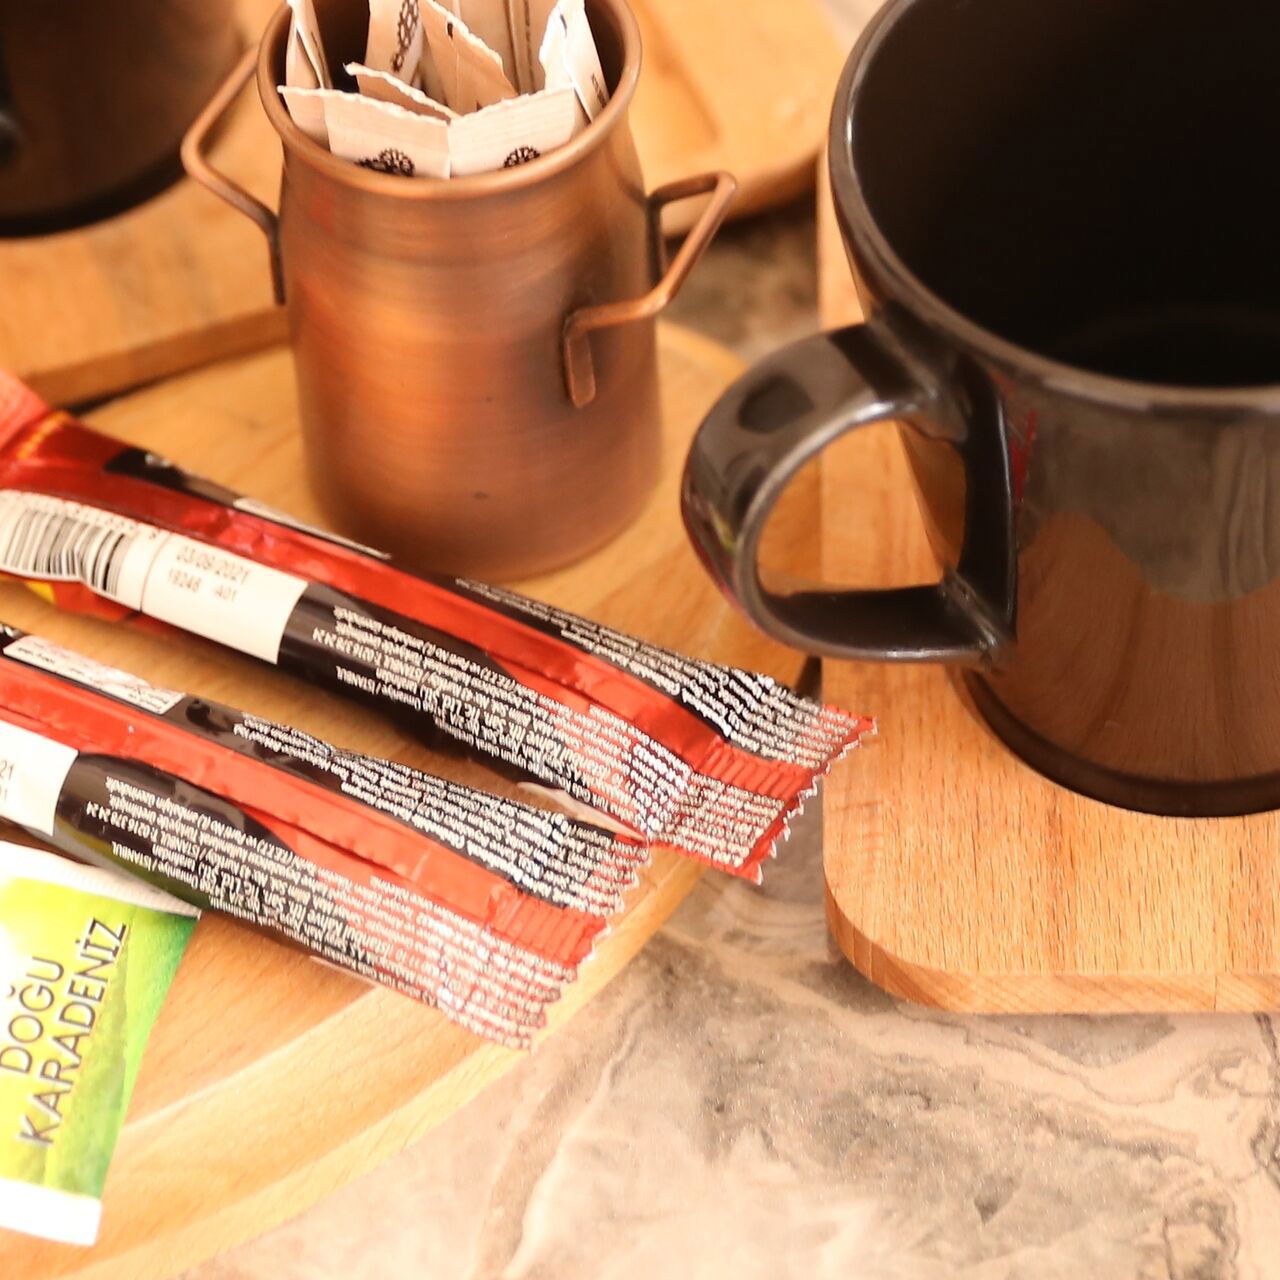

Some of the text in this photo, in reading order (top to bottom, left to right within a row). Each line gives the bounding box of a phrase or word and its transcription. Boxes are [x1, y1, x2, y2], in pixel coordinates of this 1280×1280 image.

[334, 664, 375, 694] İSTANBUL
[440, 692, 461, 714] Ltd.
[482, 710, 506, 733] San.
[524, 729, 561, 759] Kahve
[127, 816, 150, 839] 0216
[109, 839, 153, 871] İSTANBUL
[158, 829, 199, 859] İSTANBUL
[219, 870, 241, 892] Ltd.
[261, 888, 285, 911] San.
[306, 907, 342, 936] Kahve
[19, 918, 126, 1144] KARADENİZ
